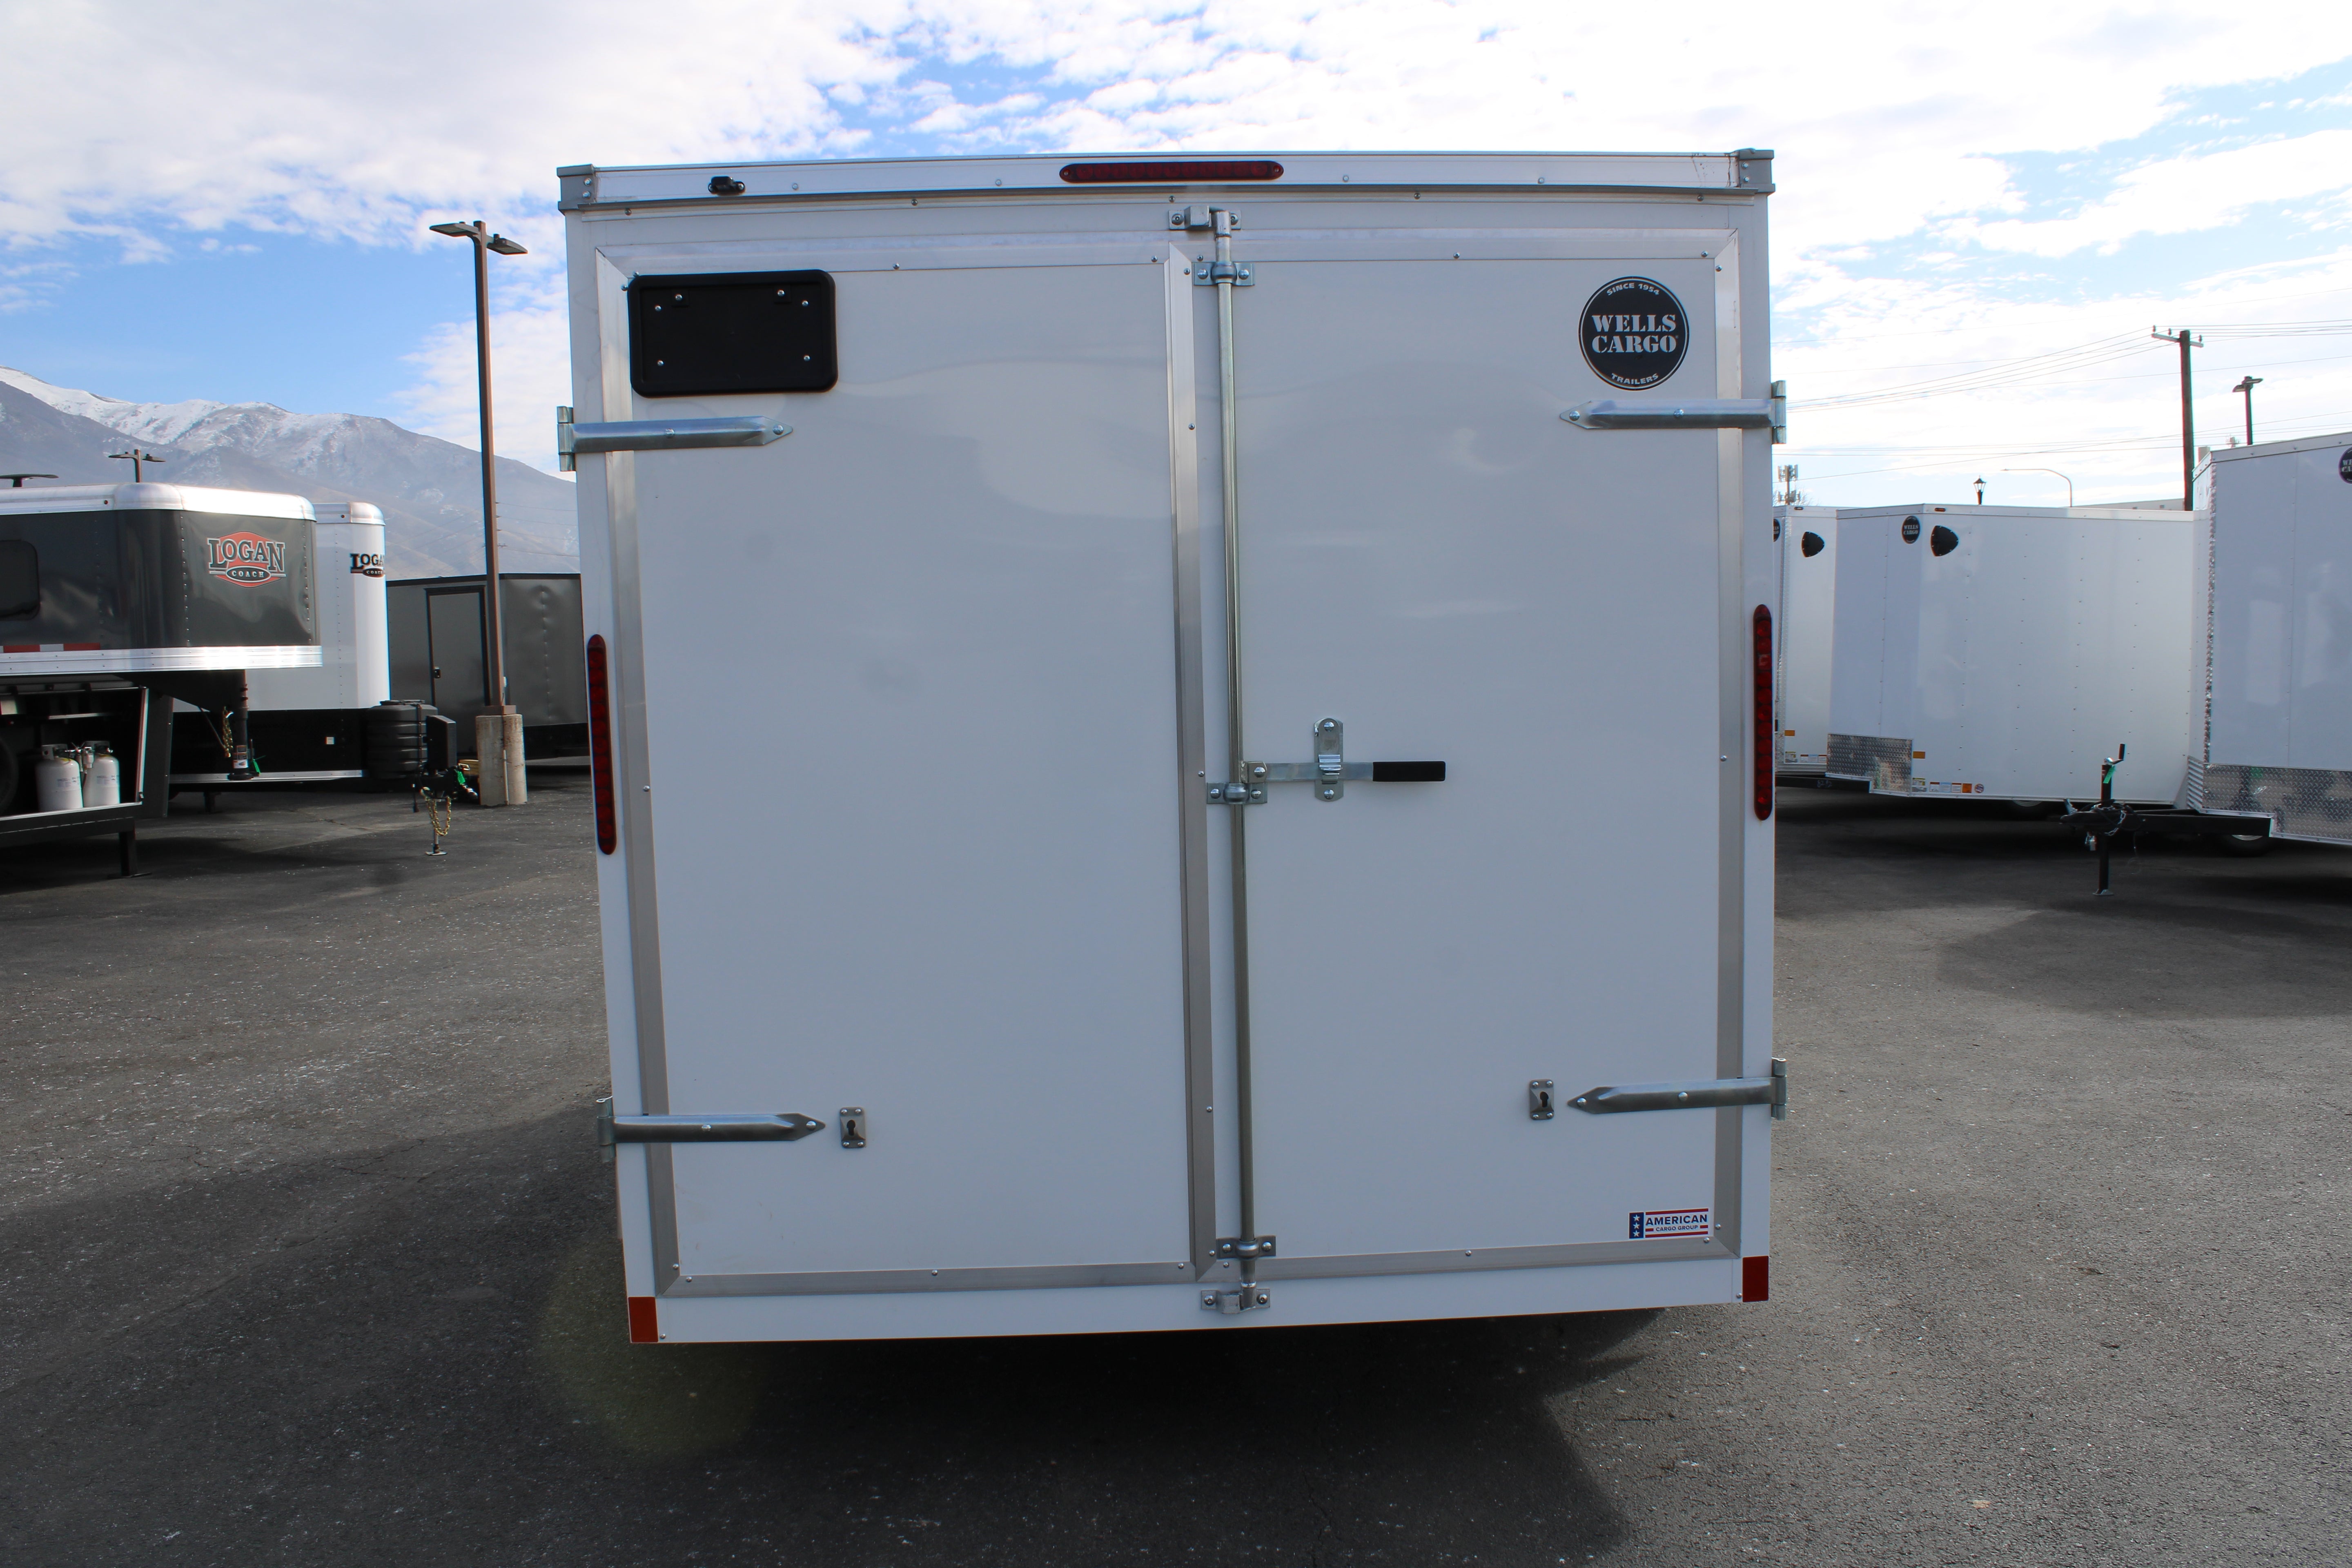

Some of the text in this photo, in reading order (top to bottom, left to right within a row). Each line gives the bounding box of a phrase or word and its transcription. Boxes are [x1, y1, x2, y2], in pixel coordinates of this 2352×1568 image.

[1606, 283, 1659, 296] SINCE 1954
[1591, 314, 1676, 332] WELLS
[1592, 335, 1677, 353] CARGO
[1611, 373, 1659, 385] TRAILERS
[207, 538, 285, 572] LOGAN
[350, 552, 384, 570] LOGA
[1646, 1214, 1707, 1225] AMERICAN
